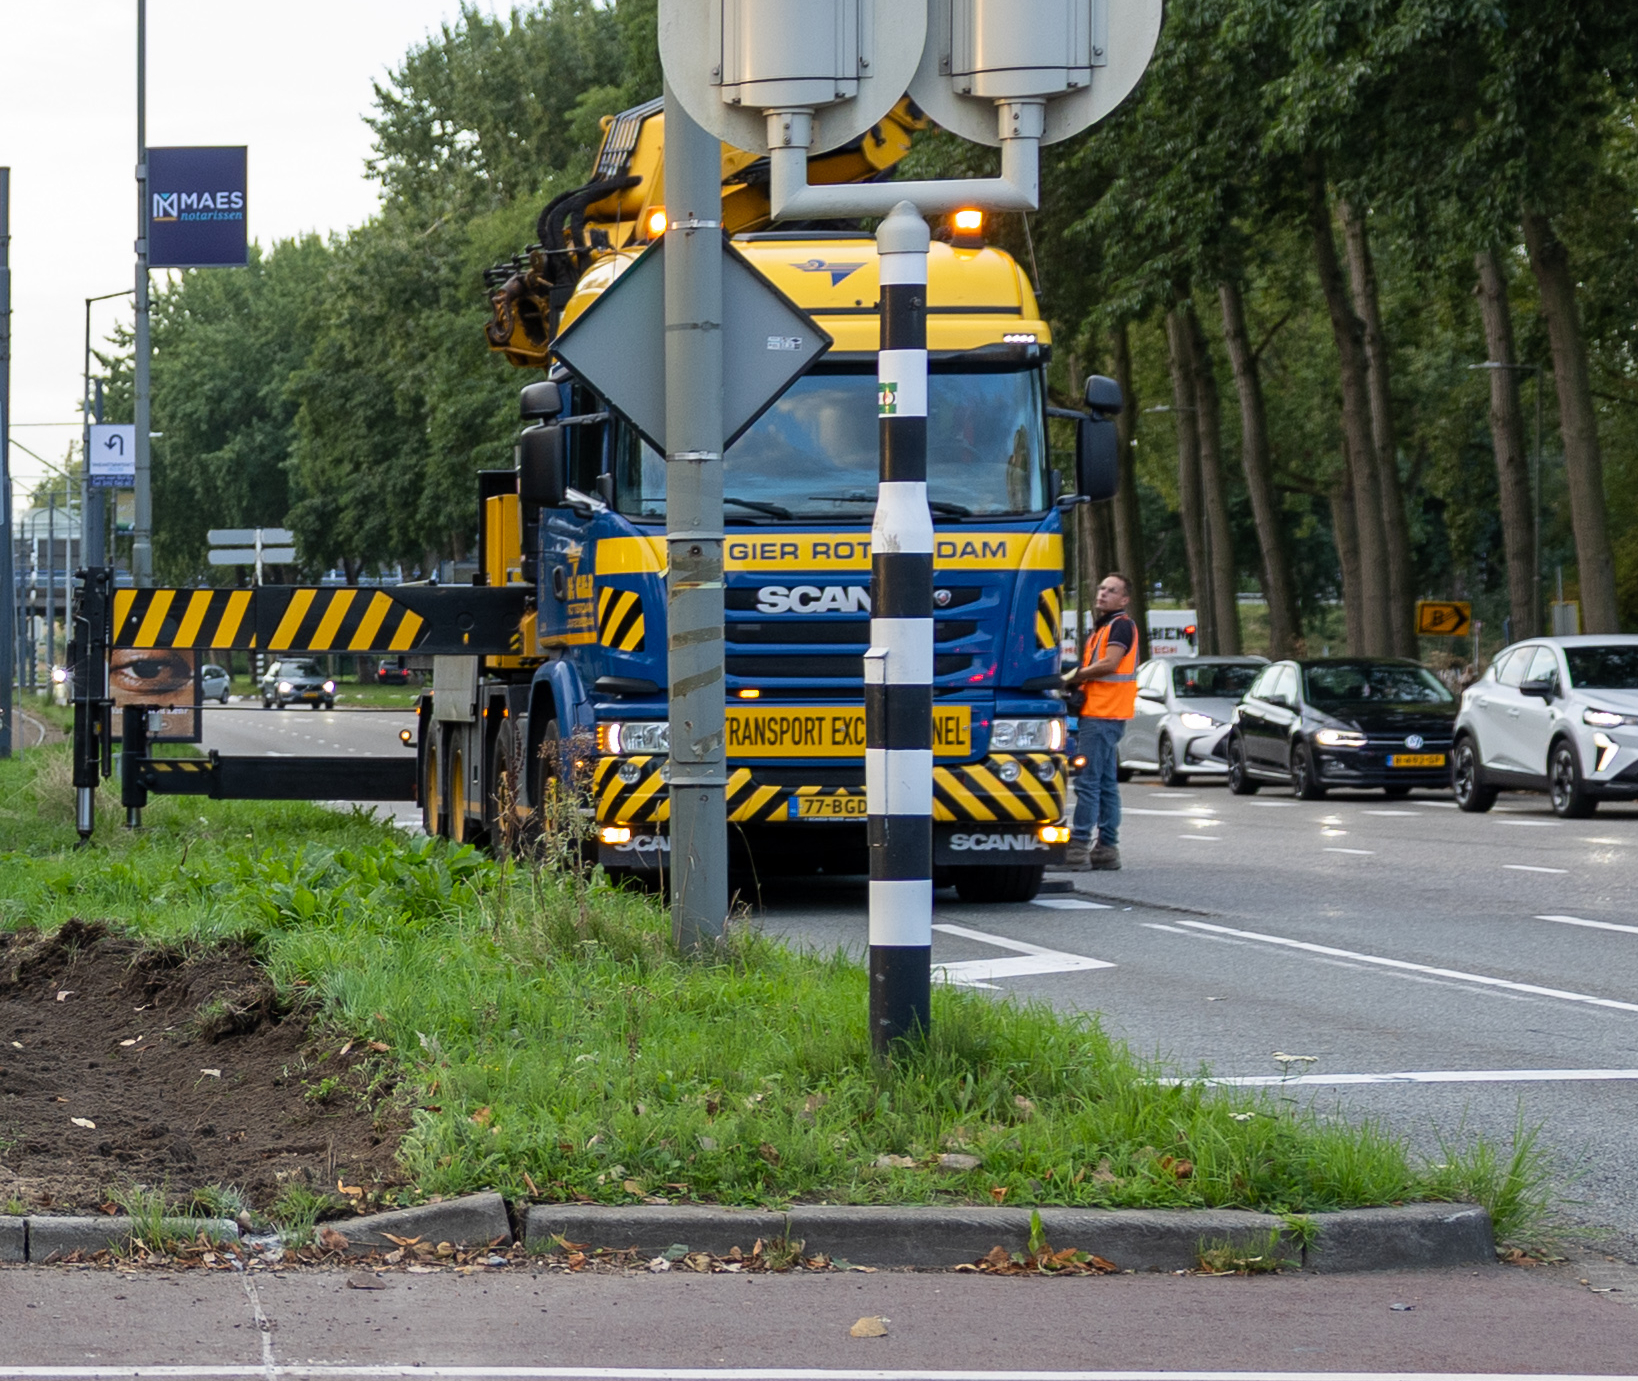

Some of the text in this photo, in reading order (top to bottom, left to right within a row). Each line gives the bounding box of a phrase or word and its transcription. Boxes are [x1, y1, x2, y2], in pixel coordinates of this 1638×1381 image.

[181, 191, 244, 209] MAES
[181, 210, 243, 220] notarissen
[729, 541, 1006, 560] GIER ROTDAM
[757, 585, 871, 613] SCAN
[725, 716, 966, 746] RANSPORT EXCNEL
[949, 834, 1050, 851] SCANIA
